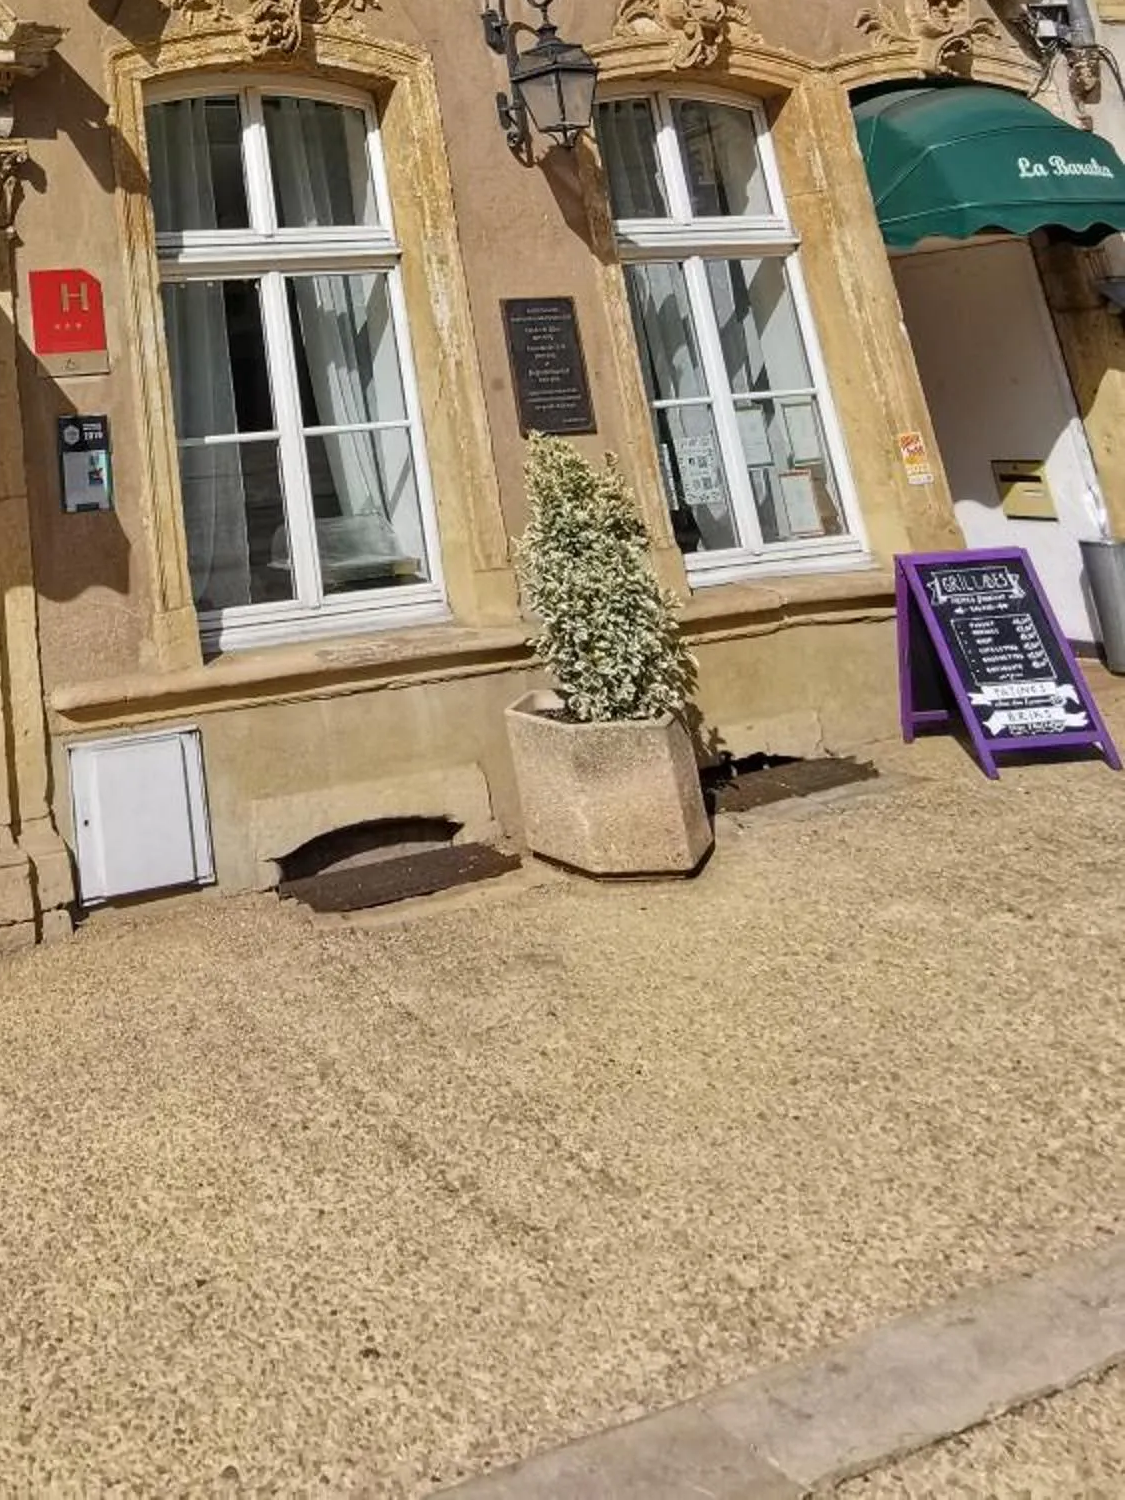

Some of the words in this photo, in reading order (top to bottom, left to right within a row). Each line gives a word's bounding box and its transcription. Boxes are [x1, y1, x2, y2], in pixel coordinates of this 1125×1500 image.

[1018, 157, 1049, 178] La
[1048, 155, 1114, 179] Baraka
[60, 282, 89, 313] H
